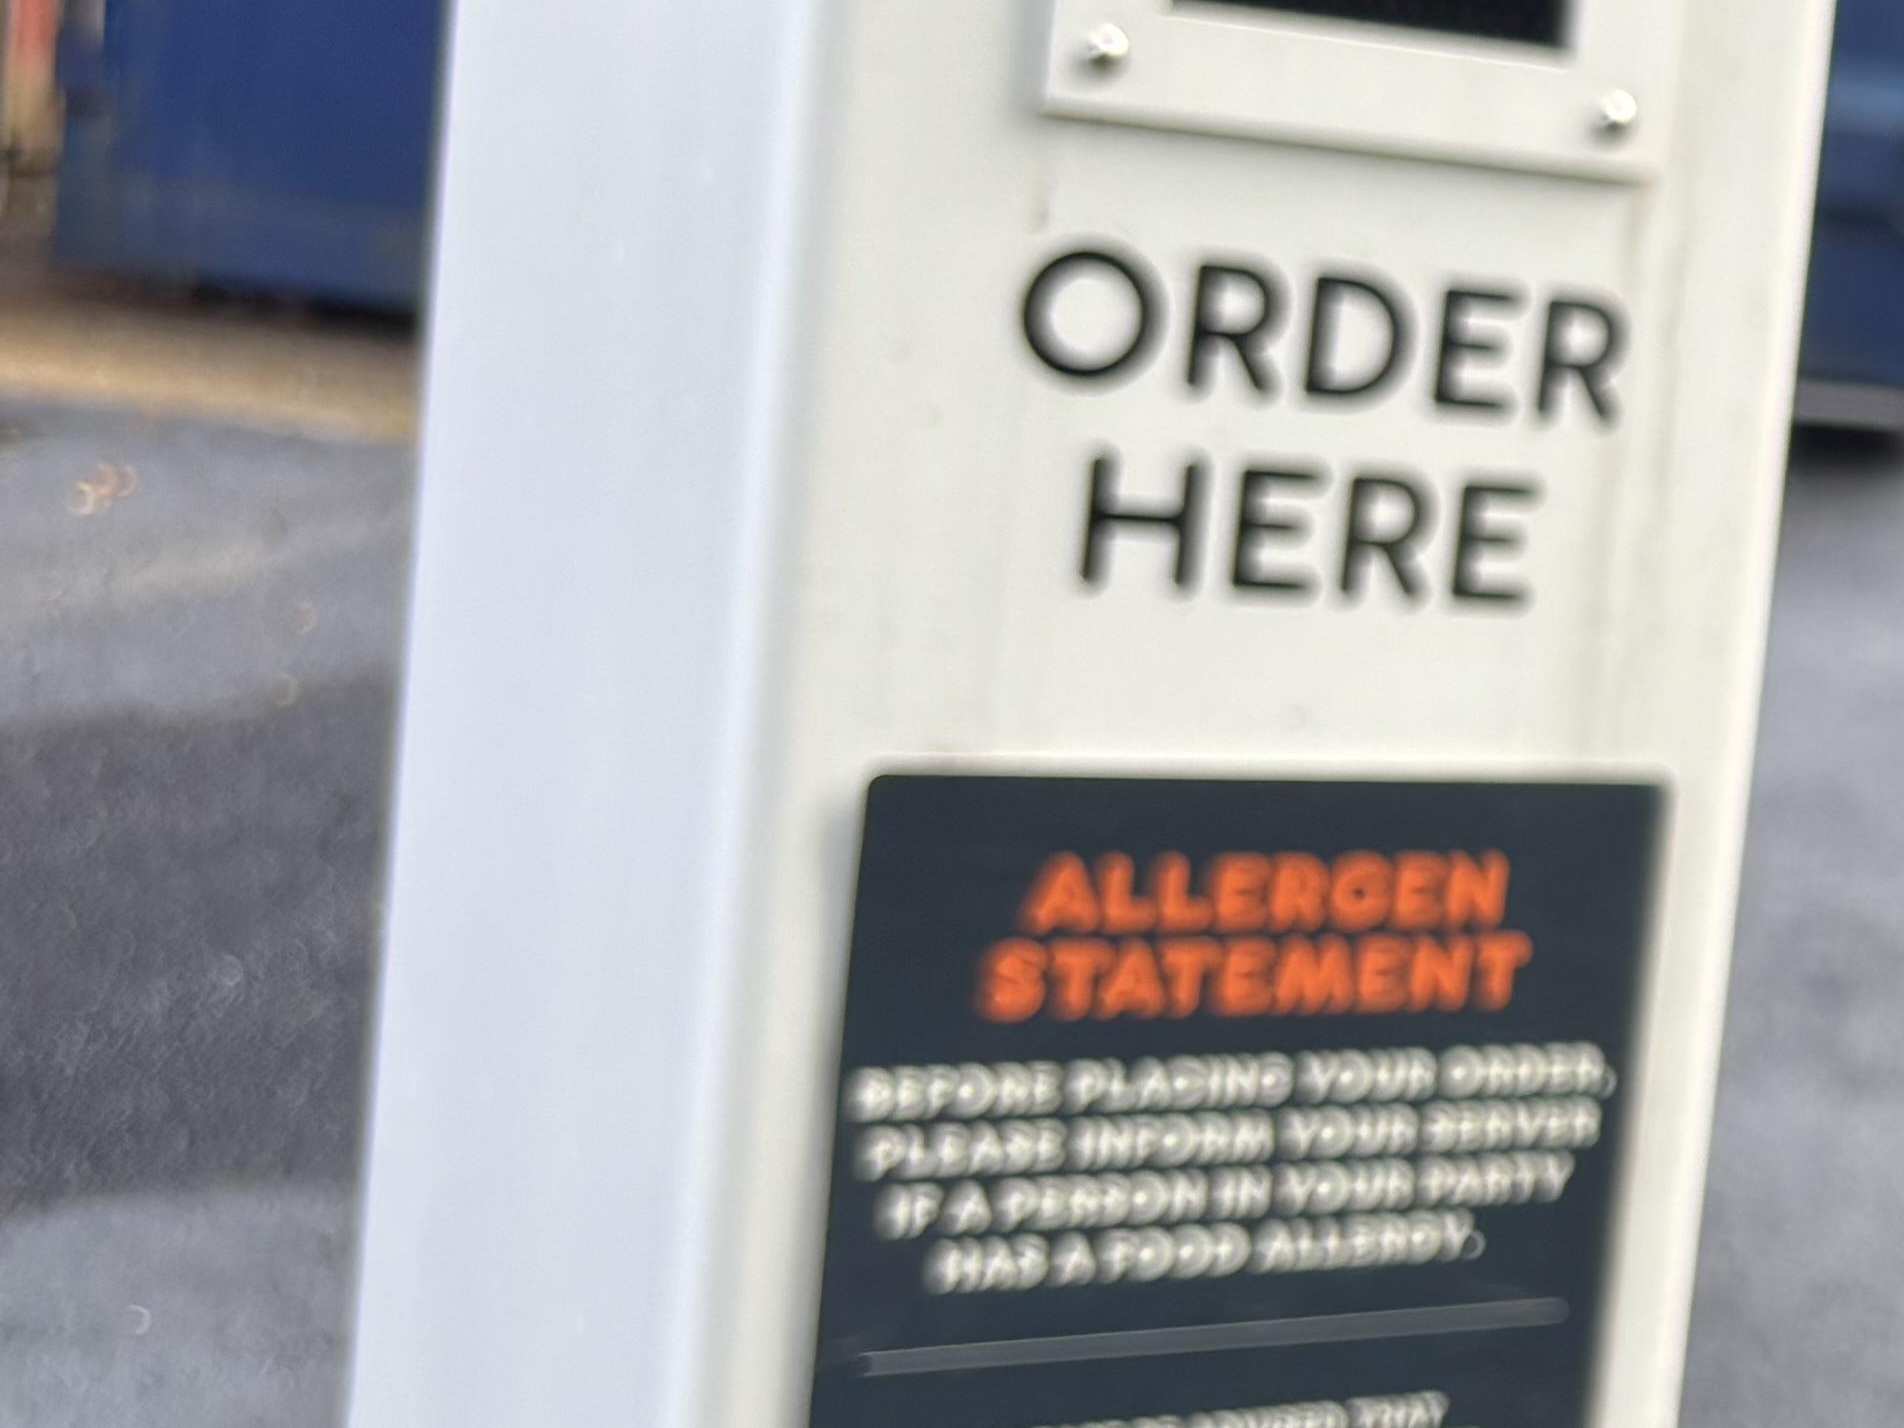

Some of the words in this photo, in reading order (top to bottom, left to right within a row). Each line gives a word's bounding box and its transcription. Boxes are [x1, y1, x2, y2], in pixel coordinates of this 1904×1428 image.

[1019, 244, 1630, 426] ORDER
[1075, 448, 1545, 610] HERE
[1015, 850, 1510, 936] ALLERGEN
[973, 929, 1534, 1024] STATEMENT
[845, 1059, 1063, 1123] BEFORE
[1061, 1051, 1294, 1114] PLACING
[1295, 1046, 1438, 1104] YOUR
[853, 1115, 1068, 1182] PLEASE
[1067, 1107, 1274, 1171] INFORM
[1275, 1102, 1419, 1160] YOUR
[873, 1181, 944, 1240] IF
[940, 1178, 993, 1235] A
[993, 1169, 1208, 1233] PERSON
[1207, 1163, 1272, 1219] IN
[1272, 1156, 1415, 1215] YOUR
[922, 1232, 1050, 1295] HAS
[1046, 1230, 1097, 1289] A
[1096, 1220, 1251, 1284] FOOD
